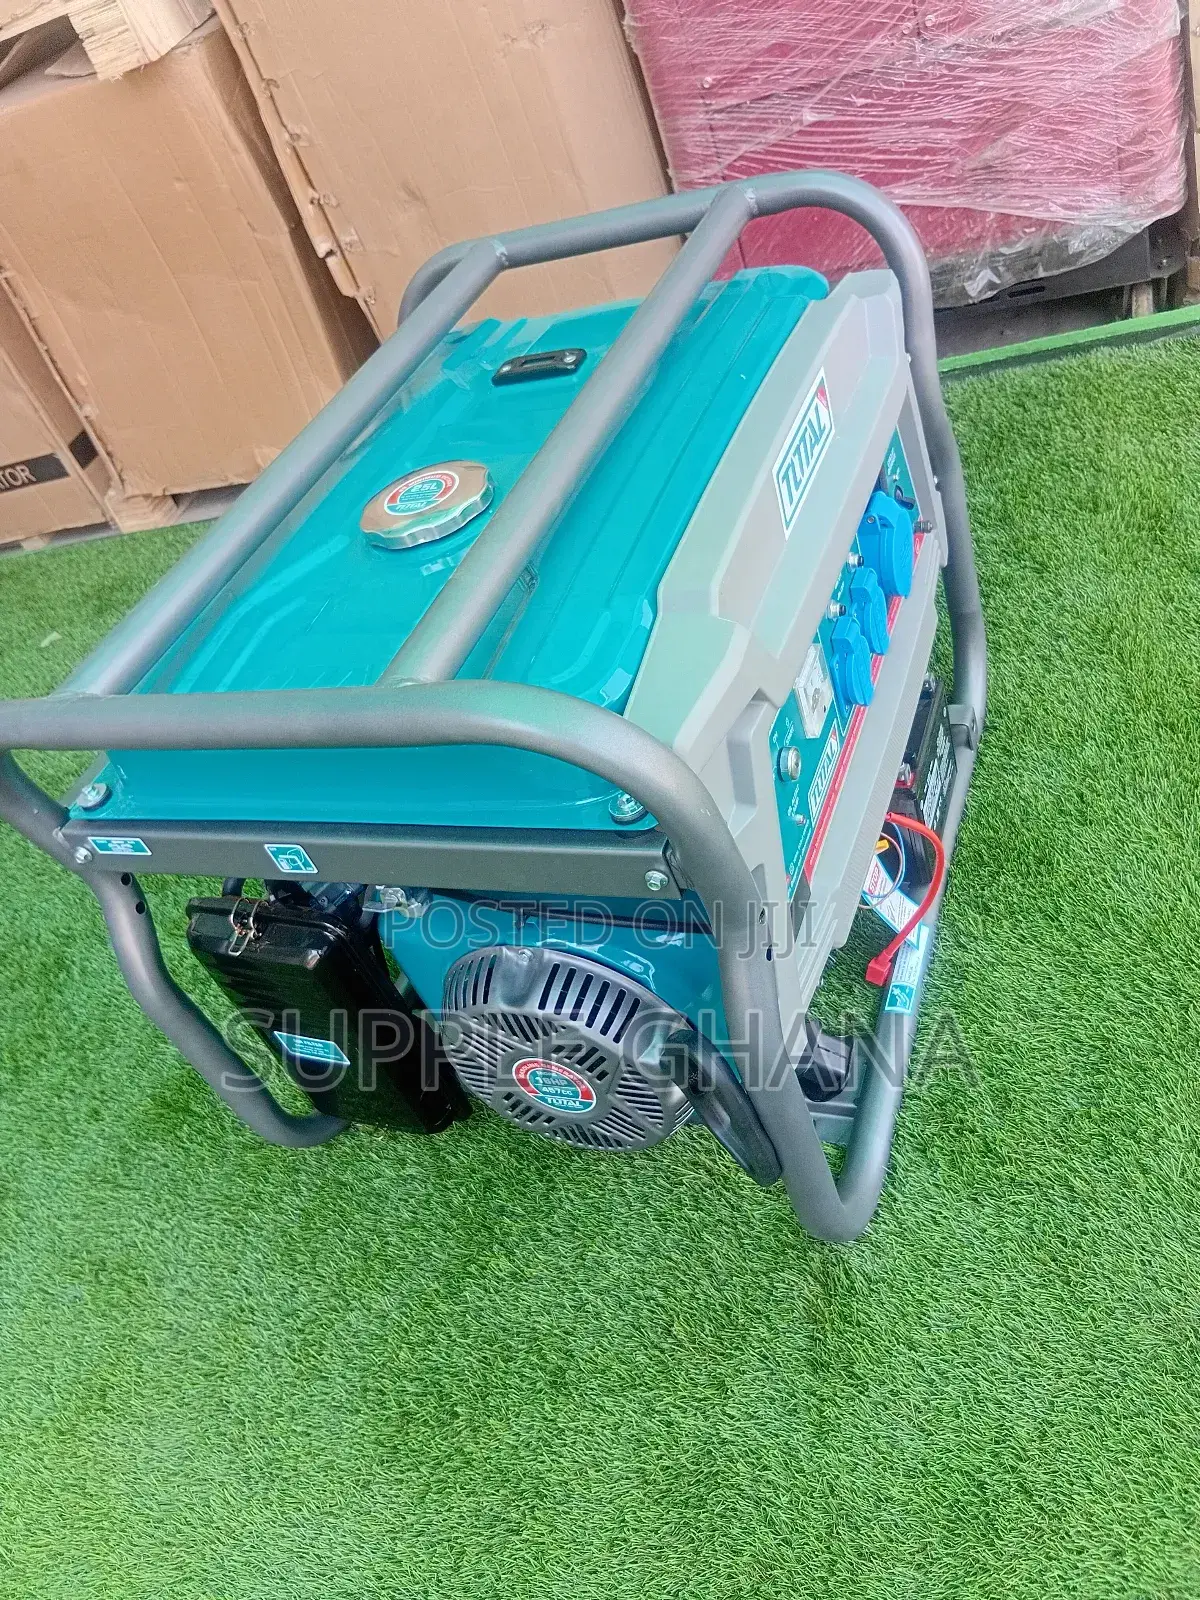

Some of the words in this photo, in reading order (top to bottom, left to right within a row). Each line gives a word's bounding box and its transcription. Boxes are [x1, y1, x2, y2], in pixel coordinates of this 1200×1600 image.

[781, 402, 826, 507] TOTAL
[395, 501, 428, 512] TOTAL
[810, 740, 837, 817] TOTAL
[869, 866, 881, 895] STOP
[545, 1097, 581, 1106] TOTAL
